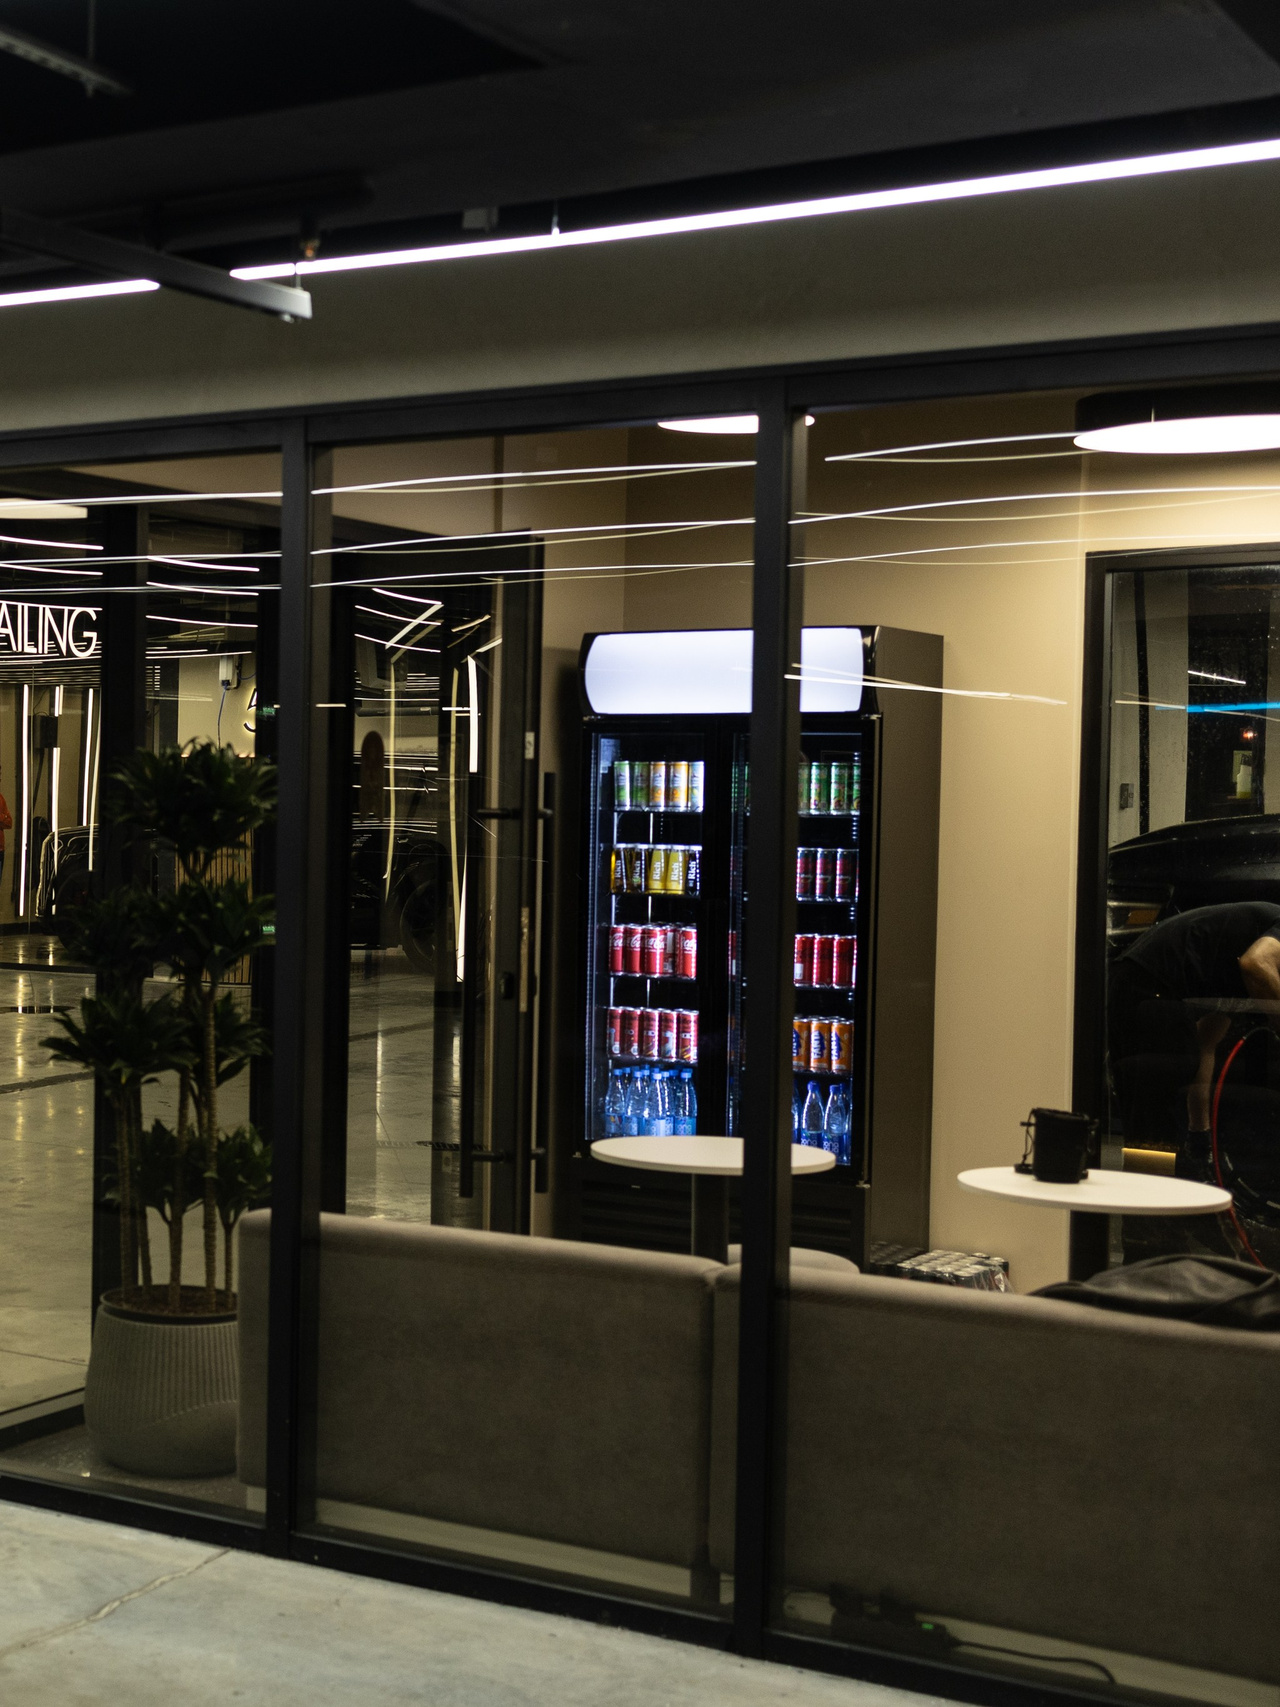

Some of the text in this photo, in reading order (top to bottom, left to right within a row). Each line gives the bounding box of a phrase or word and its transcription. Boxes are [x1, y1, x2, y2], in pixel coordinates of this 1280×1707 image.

[653, 862, 661, 880] Rich
[671, 862, 679, 880] Rich
[688, 861, 696, 880] Rich
